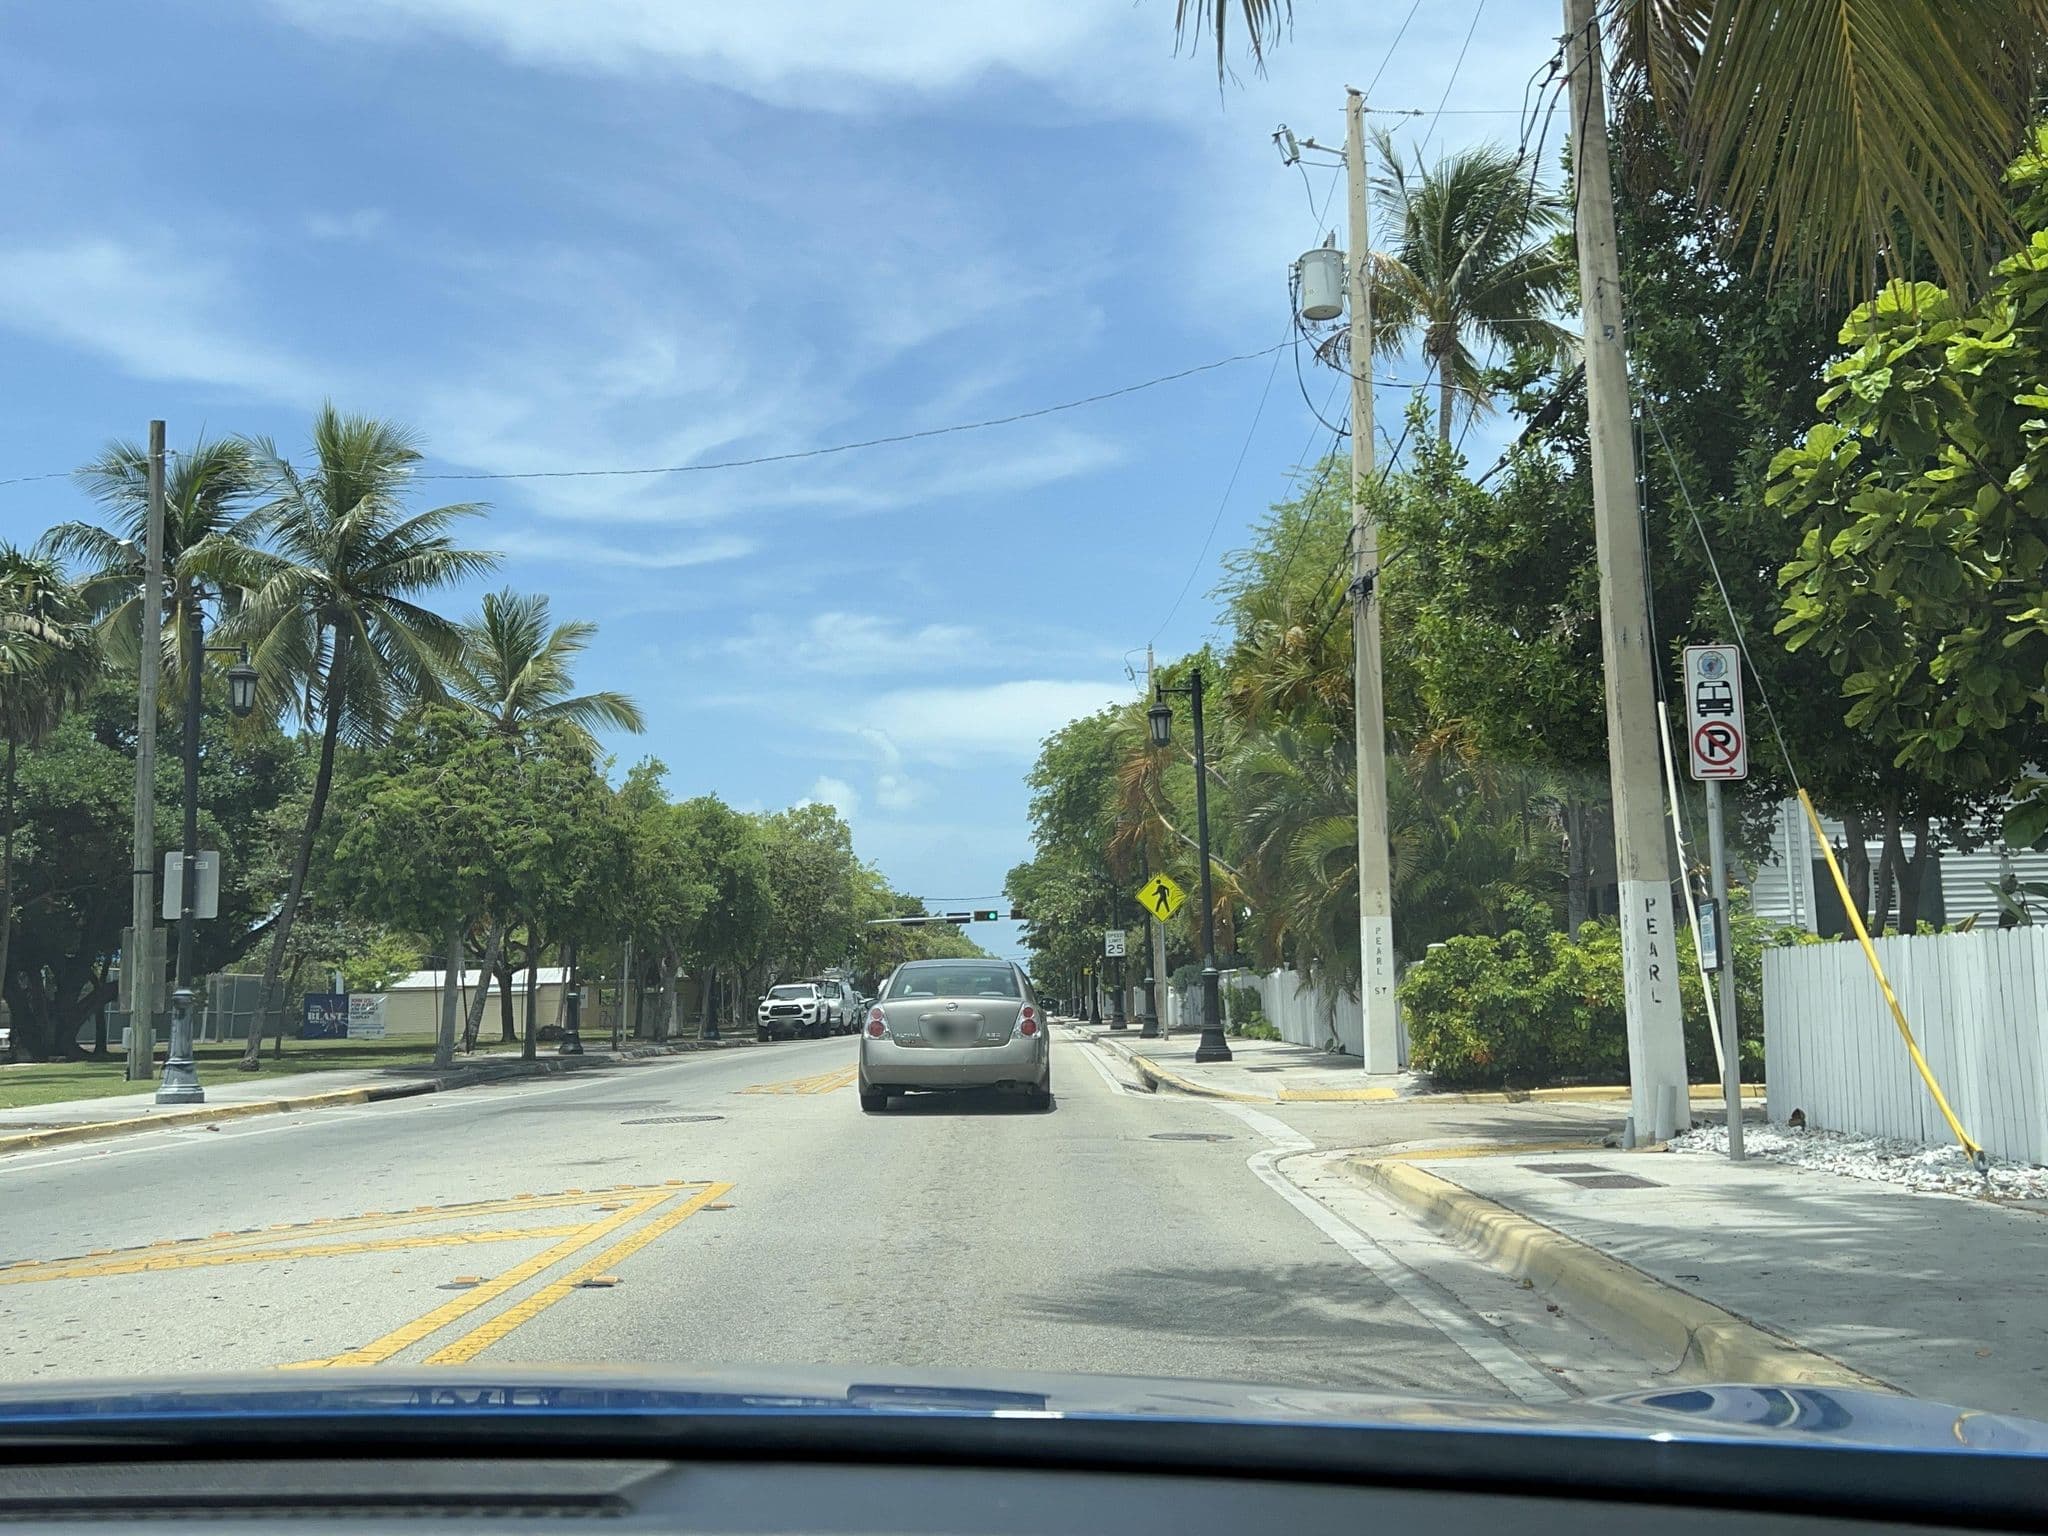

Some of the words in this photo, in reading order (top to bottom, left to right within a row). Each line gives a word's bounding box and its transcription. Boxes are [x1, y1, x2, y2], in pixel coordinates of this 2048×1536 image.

[1108, 944, 1123, 954] 25
[1375, 927, 1383, 976] PEARL
[1644, 897, 1662, 1004] PEARL
[1374, 986, 1388, 995] ST
[308, 1012, 344, 1021] BLAST
